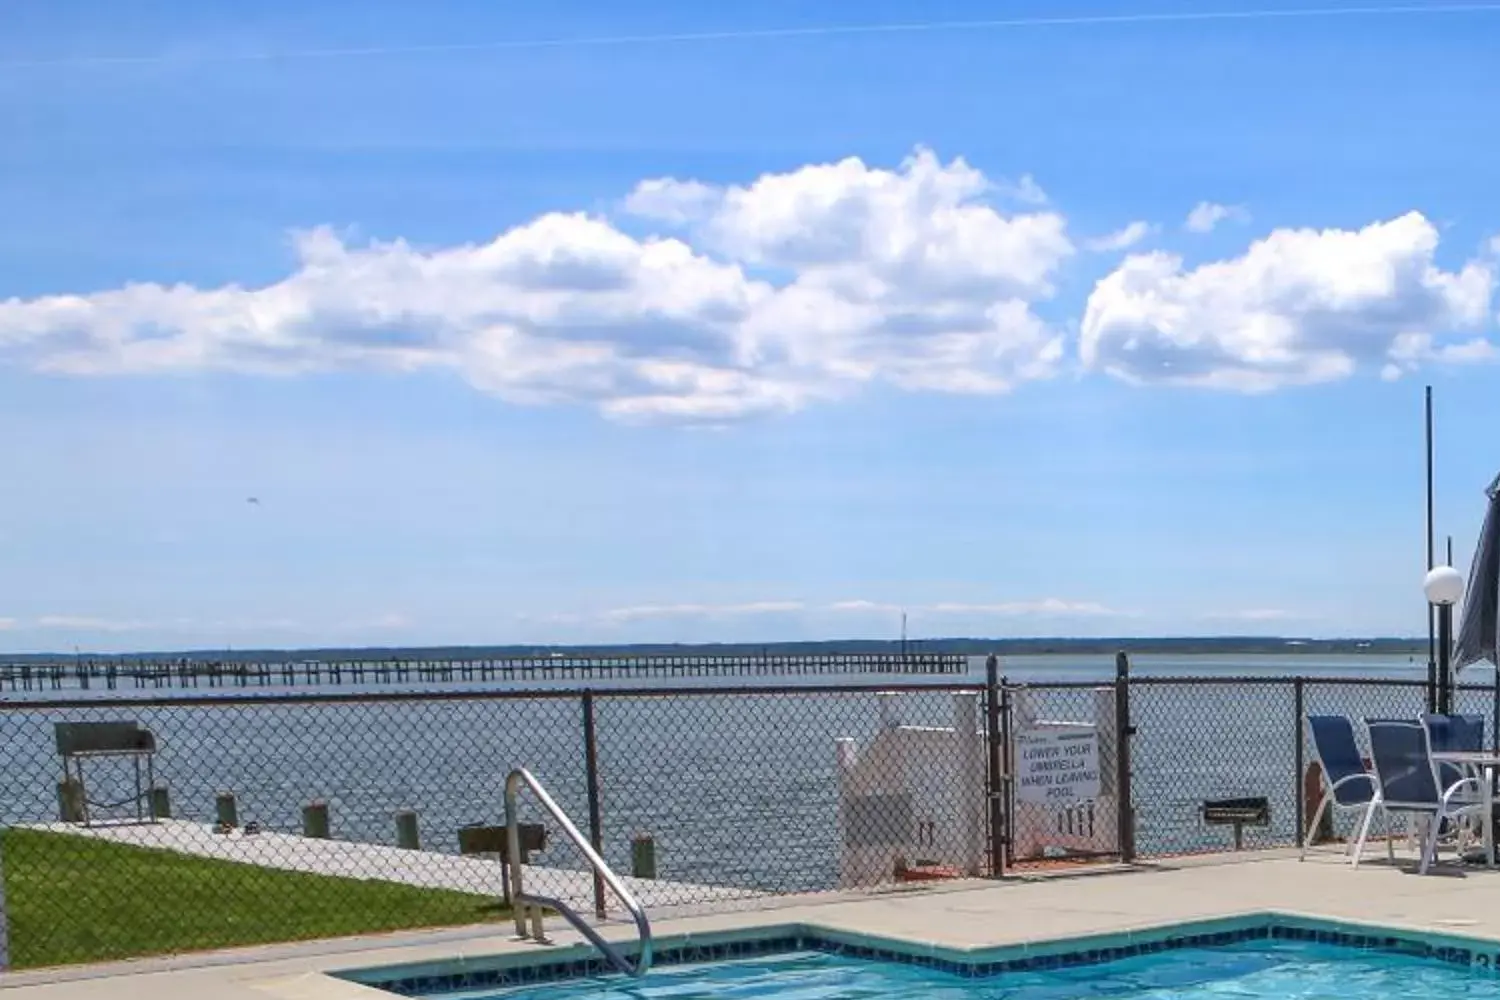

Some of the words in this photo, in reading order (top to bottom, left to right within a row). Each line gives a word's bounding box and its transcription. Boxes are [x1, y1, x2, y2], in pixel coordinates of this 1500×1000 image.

[1023, 747, 1060, 760] LOWER
[1063, 744, 1091, 756] YOUR
[1030, 760, 1085, 773] UMBRELLA
[1021, 775, 1053, 786] WHEN
[1055, 771, 1098, 785] LEAVING
[1046, 787, 1075, 798] POOL
